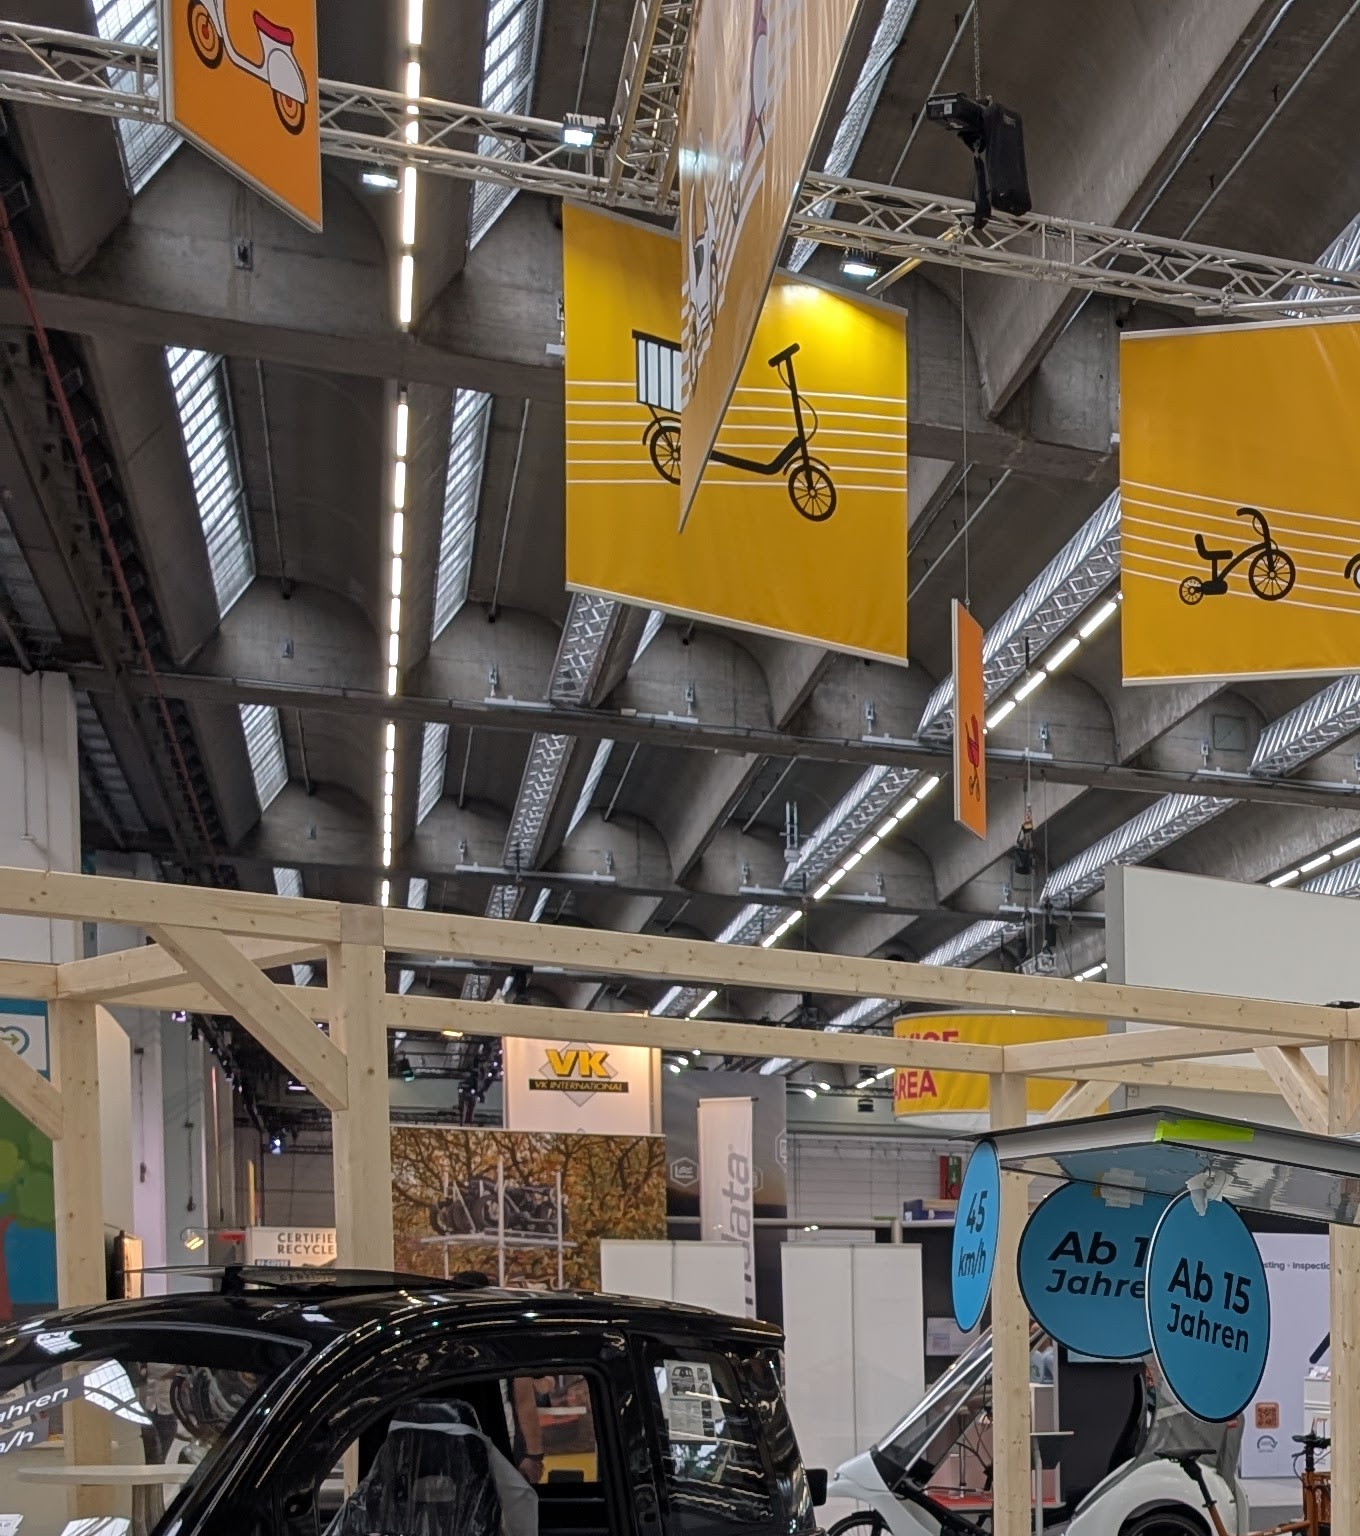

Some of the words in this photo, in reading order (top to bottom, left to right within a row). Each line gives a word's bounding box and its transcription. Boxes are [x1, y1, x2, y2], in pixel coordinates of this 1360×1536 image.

[546, 1049, 610, 1079] VK
[966, 1190, 988, 1234] 45
[277, 1232, 334, 1244] CERTIFIE
[277, 1244, 335, 1255] RECYCLE
[1047, 1231, 1118, 1265] Ab
[1133, 1236, 1150, 1268] 1
[957, 1239, 987, 1279] km/h
[1292, 1261, 1331, 1272] Inspectio
[1045, 1269, 1147, 1299] Jahre
[1167, 1257, 1213, 1304] Ab
[1223, 1271, 1252, 1315] 15
[1166, 1303, 1250, 1353] Jahren
